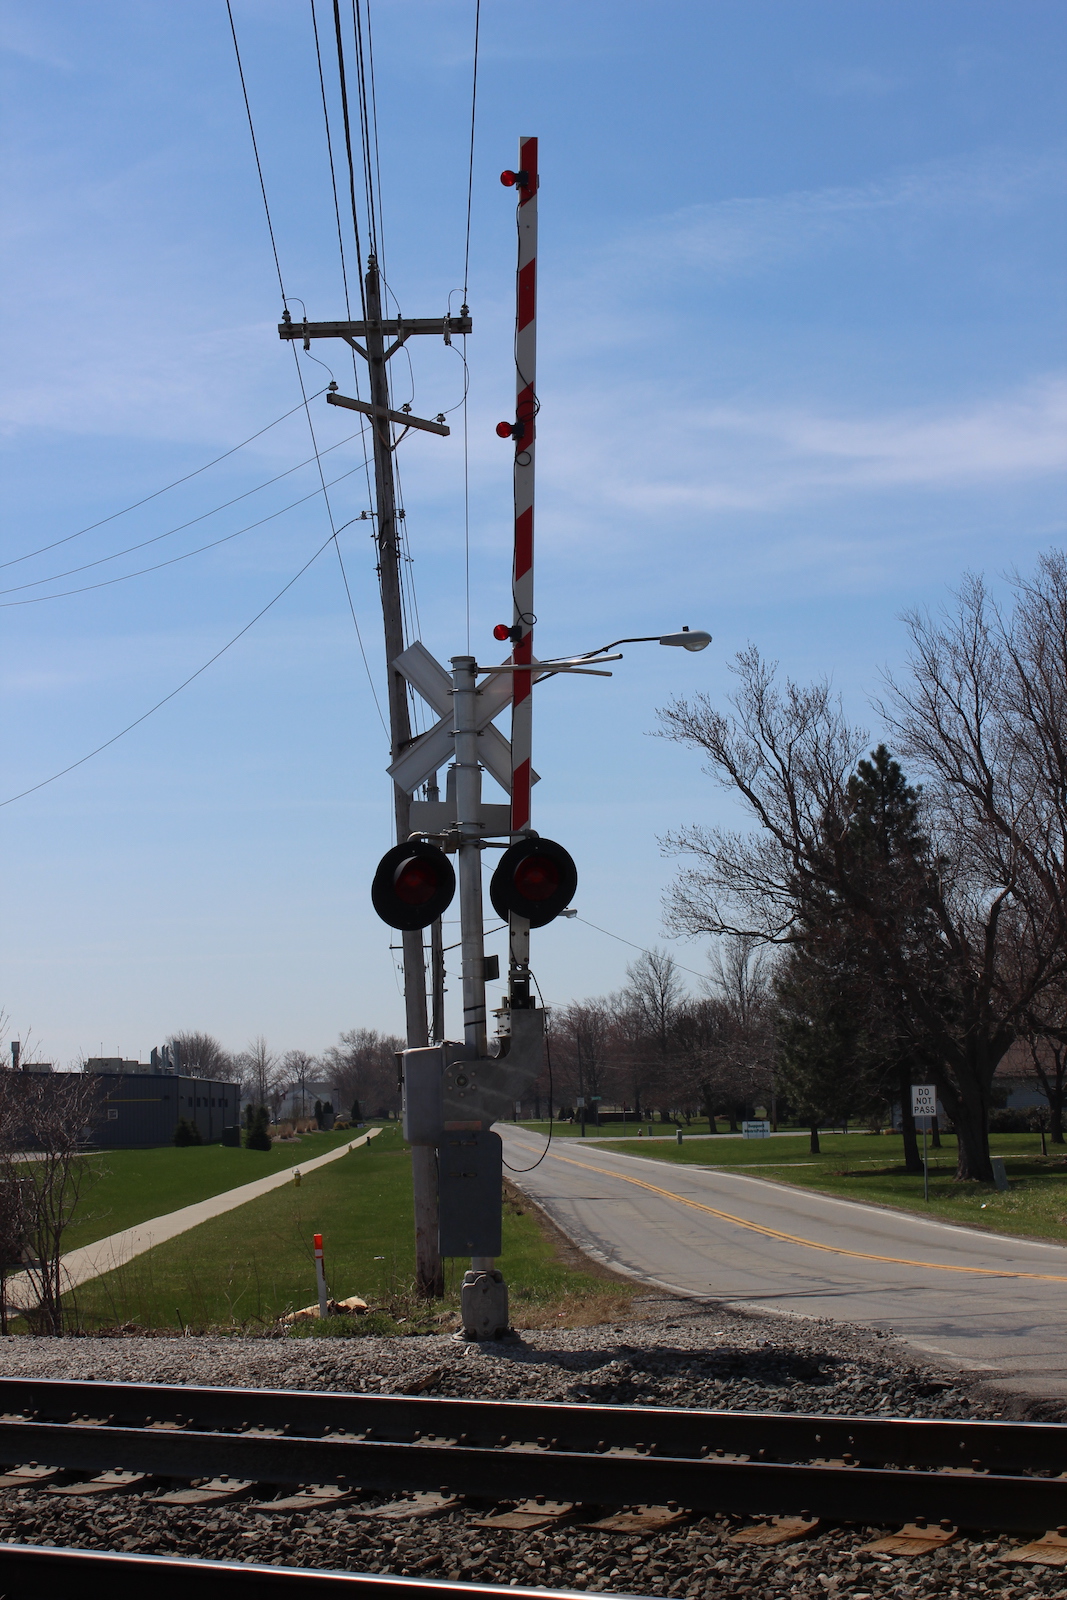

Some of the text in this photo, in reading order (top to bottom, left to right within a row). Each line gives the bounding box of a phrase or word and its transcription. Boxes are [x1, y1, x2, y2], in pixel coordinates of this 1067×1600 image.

[918, 1088, 930, 1096] DO
[916, 1097, 932, 1105] NOT
[914, 1106, 935, 1114] PASS
